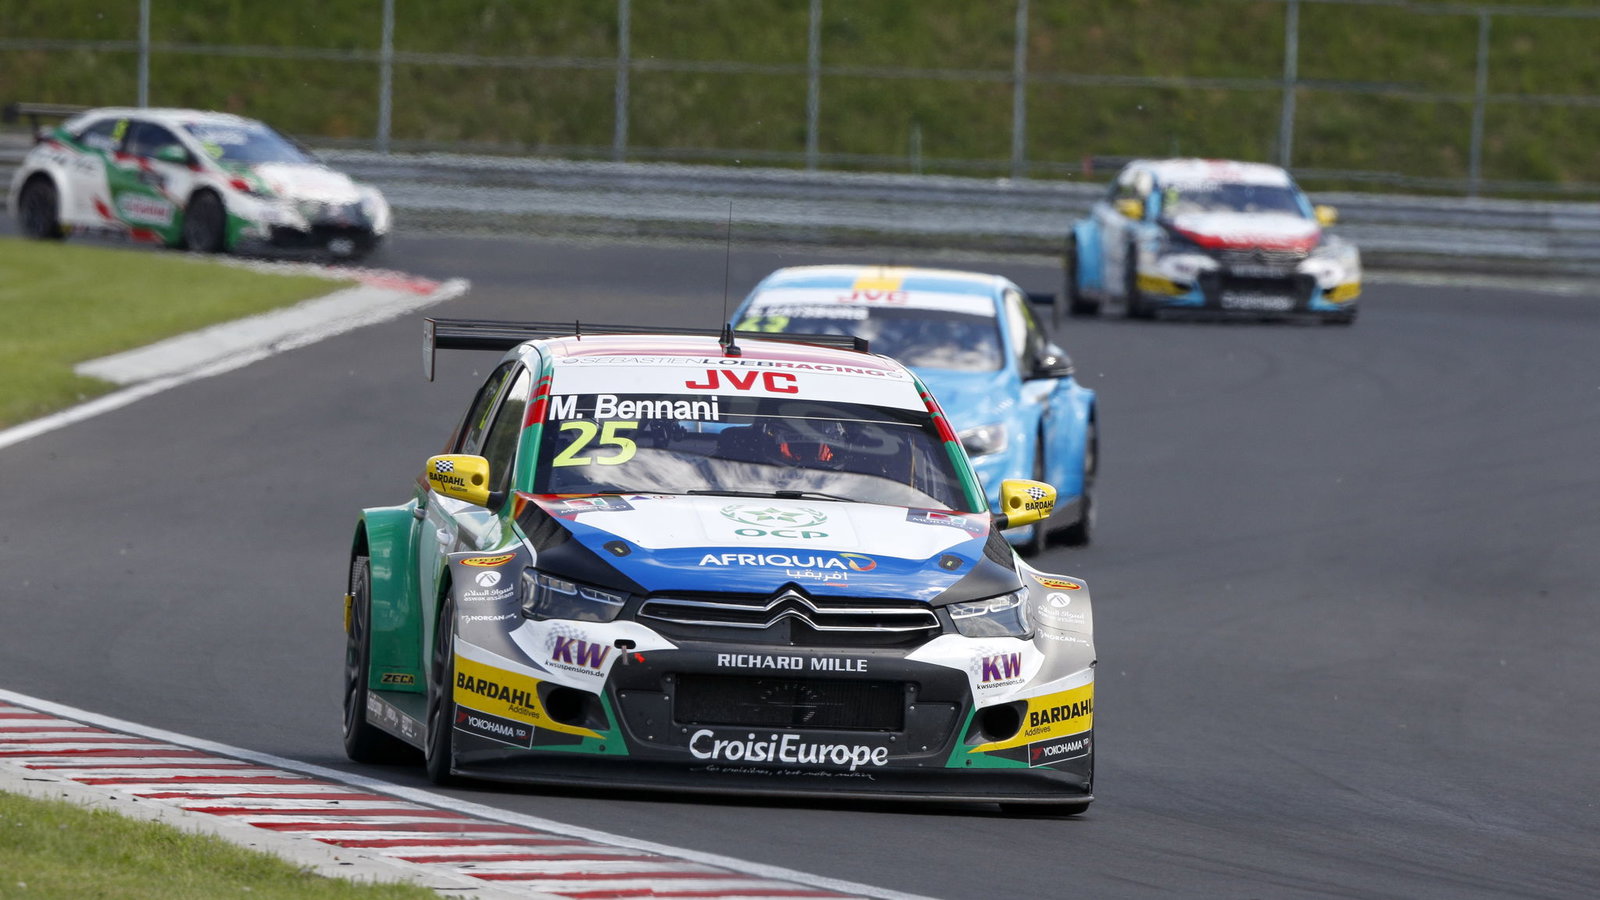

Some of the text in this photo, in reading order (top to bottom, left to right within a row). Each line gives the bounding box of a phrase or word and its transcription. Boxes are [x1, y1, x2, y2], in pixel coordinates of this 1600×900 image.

[685, 368, 799, 394] JVC
[549, 395, 720, 421] M. Bennani
[552, 420, 639, 468] 25
[428, 471, 466, 487] BARDAHL
[734, 528, 829, 539] OCP
[698, 553, 849, 570] AFRIQUIA
[551, 635, 613, 671] KW
[717, 653, 868, 673] RICHARD MILLE
[544, 659, 605, 679] kwsuspensions.de
[982, 651, 1022, 683] KW
[382, 673, 414, 684] ZECA
[456, 671, 535, 710] BARDAHL
[507, 704, 540, 720] Additives
[467, 715, 515, 738] YOKOHAMA
[1024, 726, 1051, 738] Additives
[688, 728, 889, 772] CroisiEurope
[1043, 740, 1083, 757] YOKOHAMA
